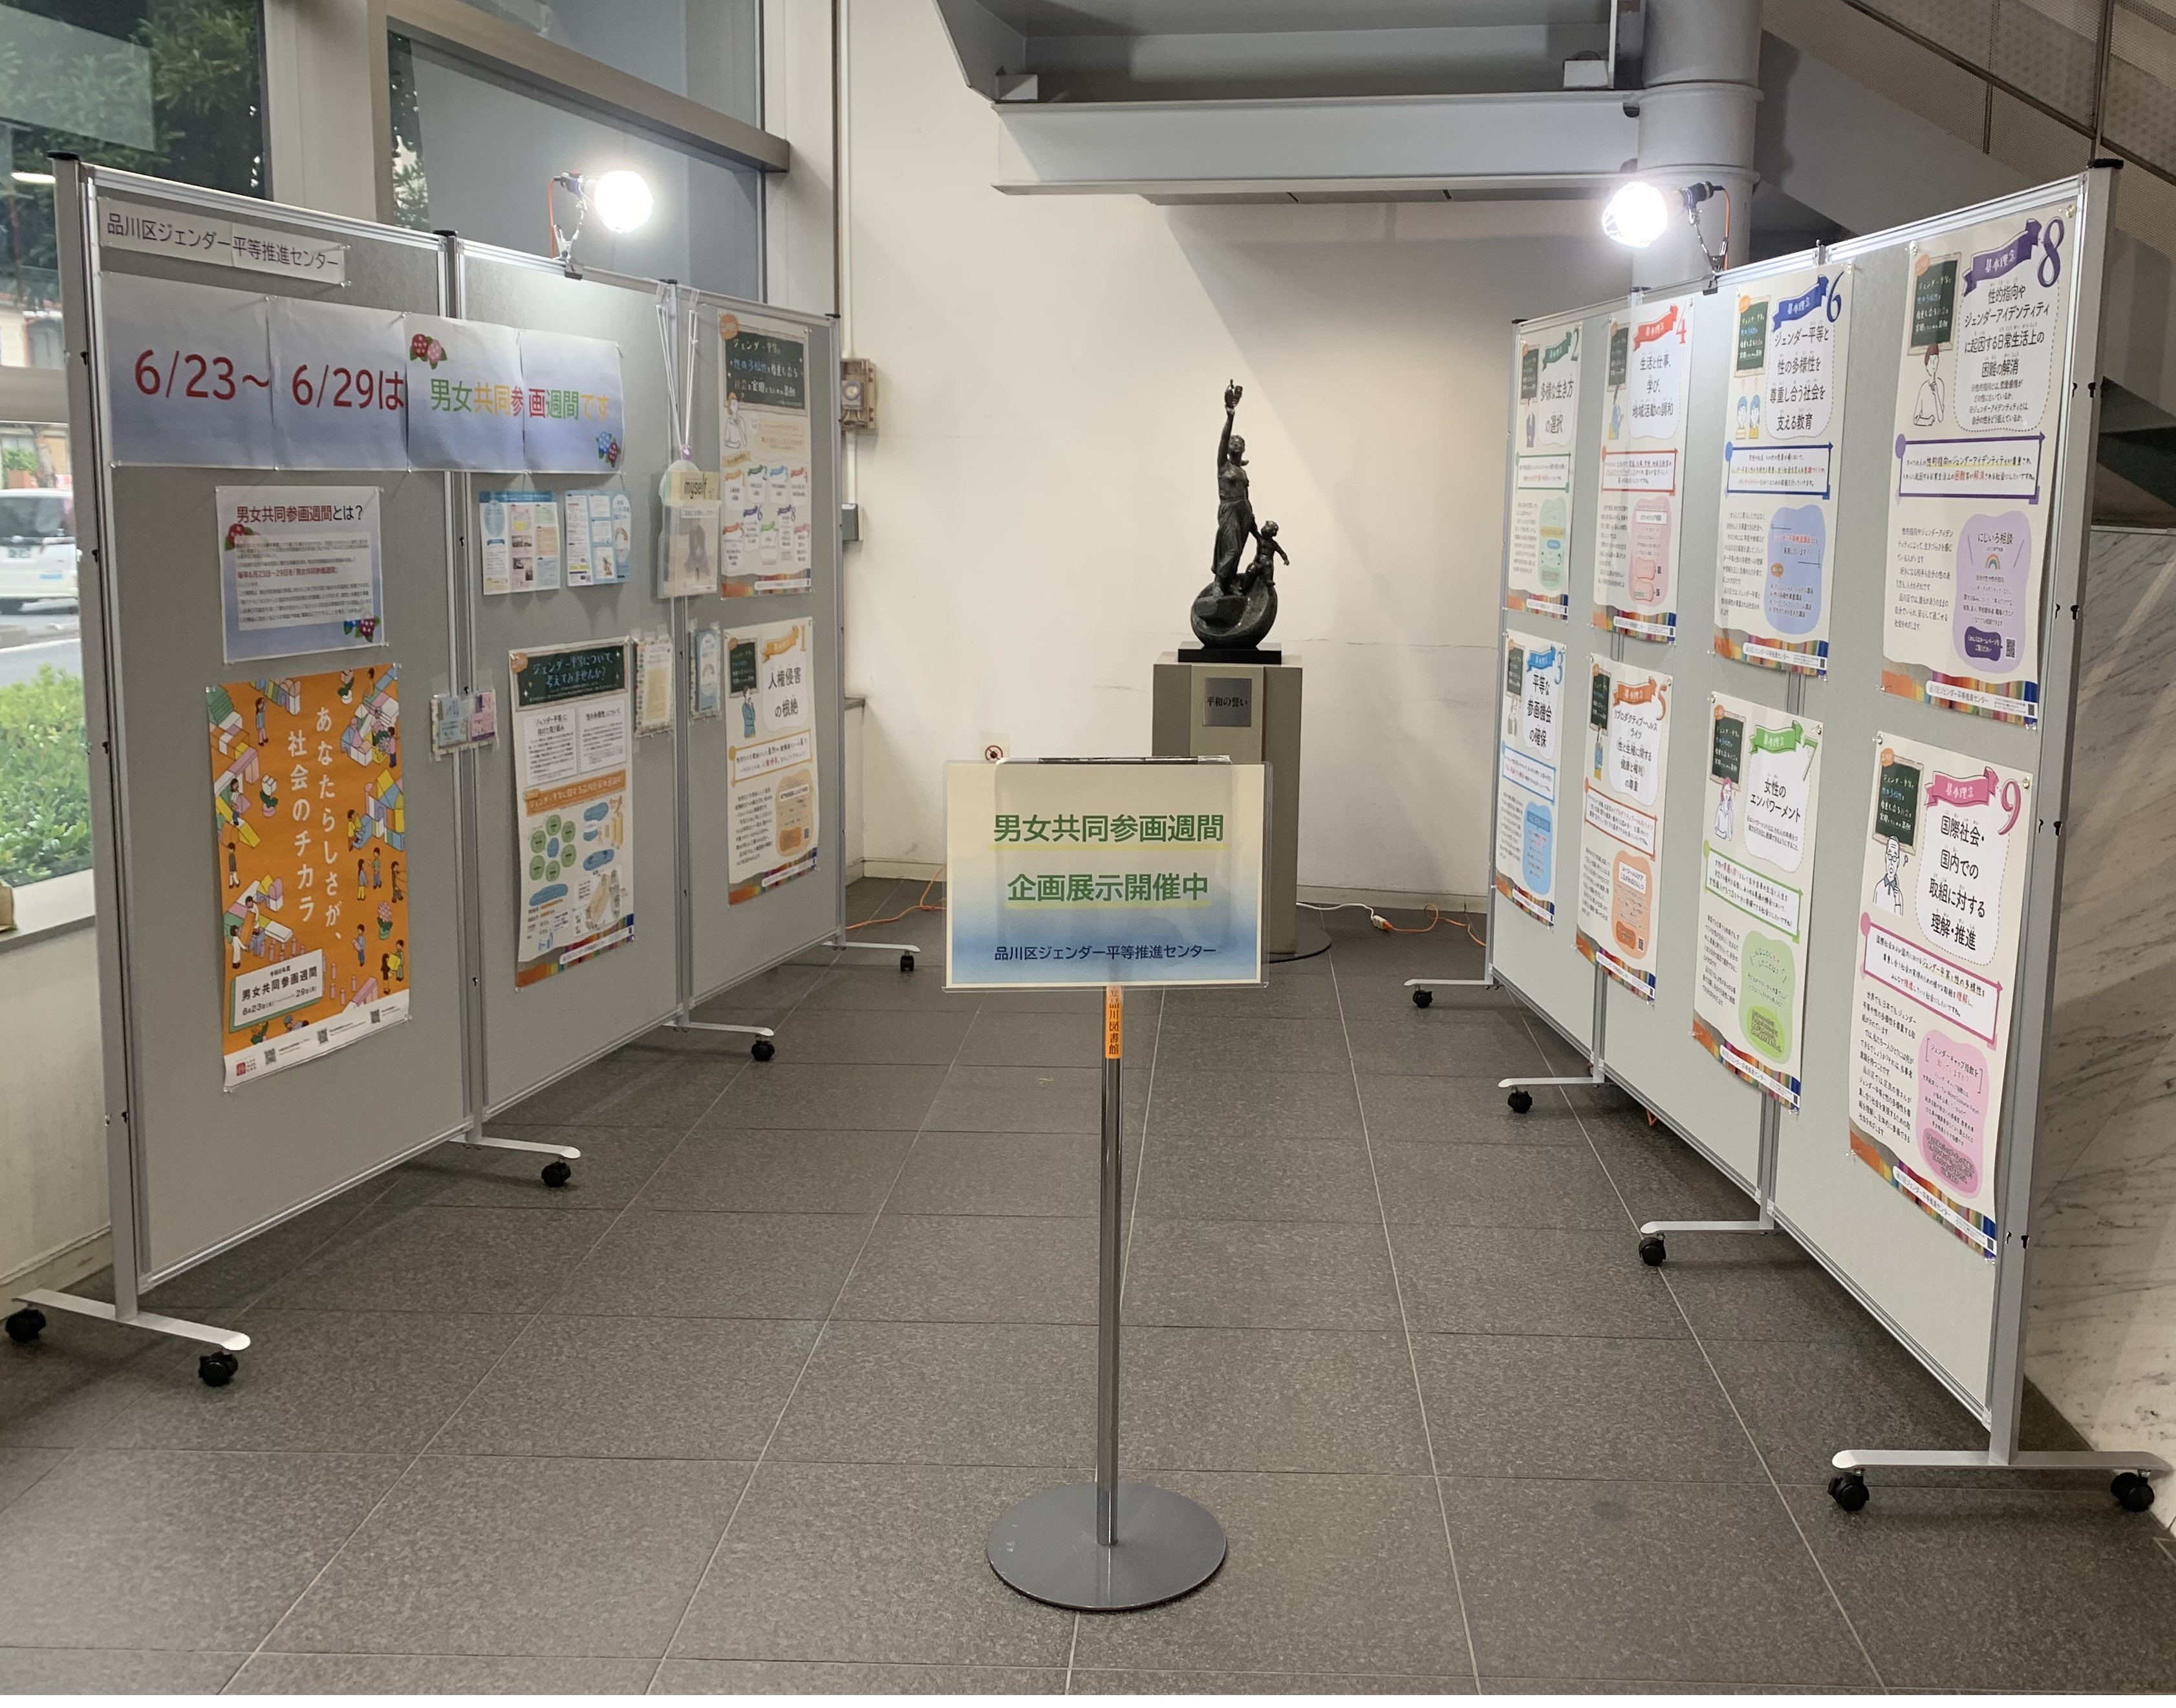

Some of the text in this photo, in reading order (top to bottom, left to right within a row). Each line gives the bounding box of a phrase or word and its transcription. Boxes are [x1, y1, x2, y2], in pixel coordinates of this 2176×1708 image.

[107, 213, 339, 270] 品川区ジェンダー平等推進センター
[2038, 217, 2065, 287] 8
[1985, 249, 2016, 273] 基本理念
[1827, 272, 1844, 323] 6
[1988, 283, 2026, 304] 性的指向や
[1787, 297, 1811, 315] 基本理念
[1965, 301, 2050, 328] ジェンダーアイデンティティ
[1675, 299, 1687, 345] 4
[1570, 327, 1579, 362] 2
[1774, 326, 1829, 347] ジェンダー平等と
[1965, 330, 2044, 354] に起因する日常生活上の
[1640, 354, 1671, 370] 生活と仕事、
[1778, 356, 1821, 375] 性の多様性を
[1981, 359, 2019, 378] 困難の解消
[292, 364, 405, 411] 6/29は
[430, 378, 610, 421] 男女共同参画週間です
[1540, 378, 1574, 401] 多様な生き方
[1769, 384, 1826, 403] 尊重し合う社会を
[1632, 401, 1674, 418] 地域活動の調和
[1546, 414, 1563, 434] の選択
[1776, 413, 1813, 431] 支える教育
[684, 477, 707, 499] myself
[237, 505, 363, 523] 男女共同参画週間とは？
[1977, 532, 2014, 544] にじいろ相談
[533, 652, 613, 675] ジェンダー平等について
[1555, 651, 1564, 685] 3
[768, 667, 801, 690] 人権侵害
[1533, 674, 1550, 696] 平等な
[775, 699, 799, 718] の根絶
[1206, 696, 1248, 707] 平和の誓い
[1527, 699, 1552, 724] 参画機会
[1656, 684, 1668, 721] 5
[1529, 726, 1547, 748] の確保
[1802, 735, 1818, 782] 7
[1624, 780, 1639, 793] の尊重
[1764, 779, 1786, 798] 女性の
[1945, 782, 1974, 799] 基本理念
[1750, 793, 1801, 823] エンパワーメント
[1998, 778, 2021, 835] 9
[288, 729, 315, 922] 社会のチカラ
[316, 707, 342, 940] あなたらしさが、
[994, 814, 1224, 842] 男女共同参画週間
[1941, 849, 1979, 879] 国内での
[1007, 873, 1208, 902] 企画展示開催中
[1928, 877, 1985, 918] 取組に対する
[1930, 913, 1977, 951] 理解・推進
[995, 945, 1216, 961] 品川区ジェンダー平等推進センター
[242, 966, 318, 1001] 男女共同参画週間
